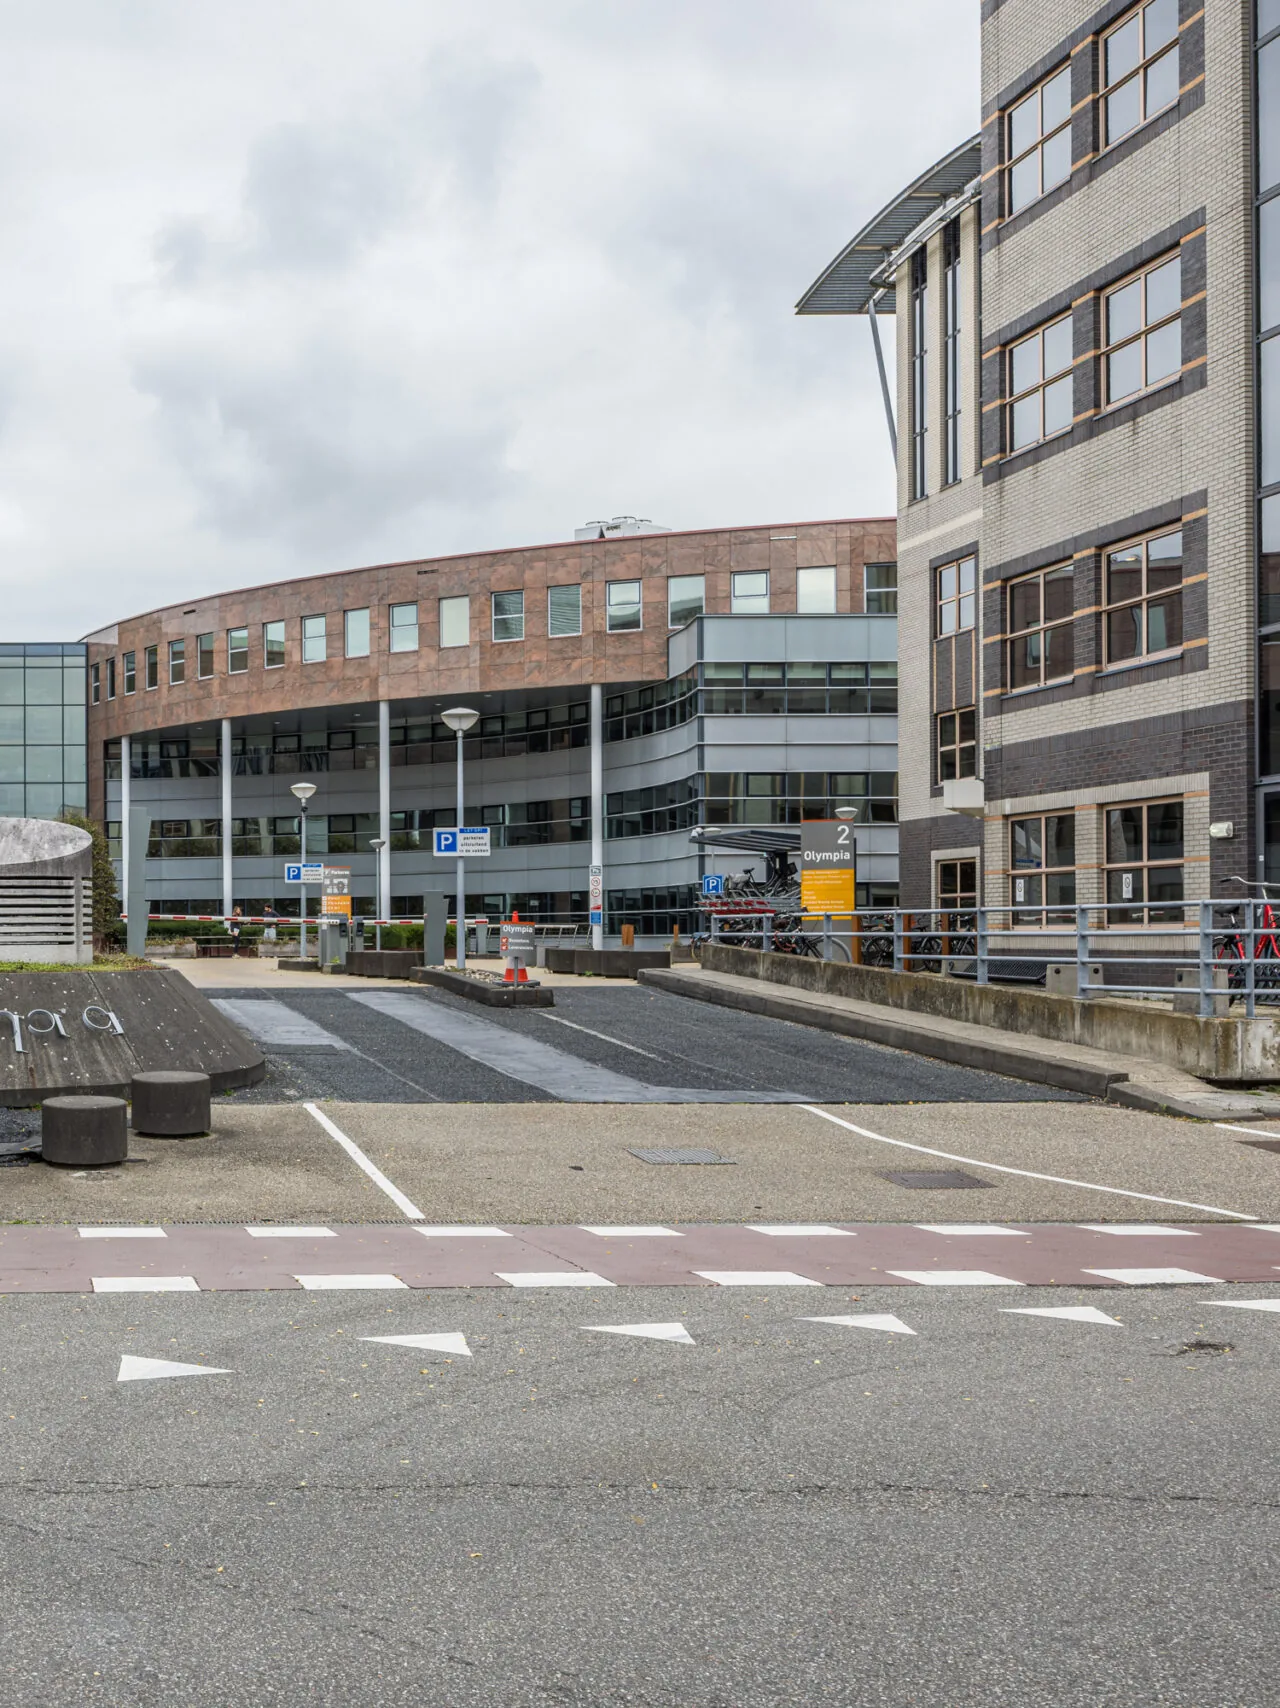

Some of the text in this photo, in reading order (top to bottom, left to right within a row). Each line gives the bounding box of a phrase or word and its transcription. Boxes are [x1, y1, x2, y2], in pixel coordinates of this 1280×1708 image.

[837, 825, 850, 844] 2
[441, 834, 452, 850] P
[804, 850, 850, 862] Olympia
[290, 868, 298, 879] P
[710, 880, 717, 890] P
[502, 925, 533, 934] Olympia
